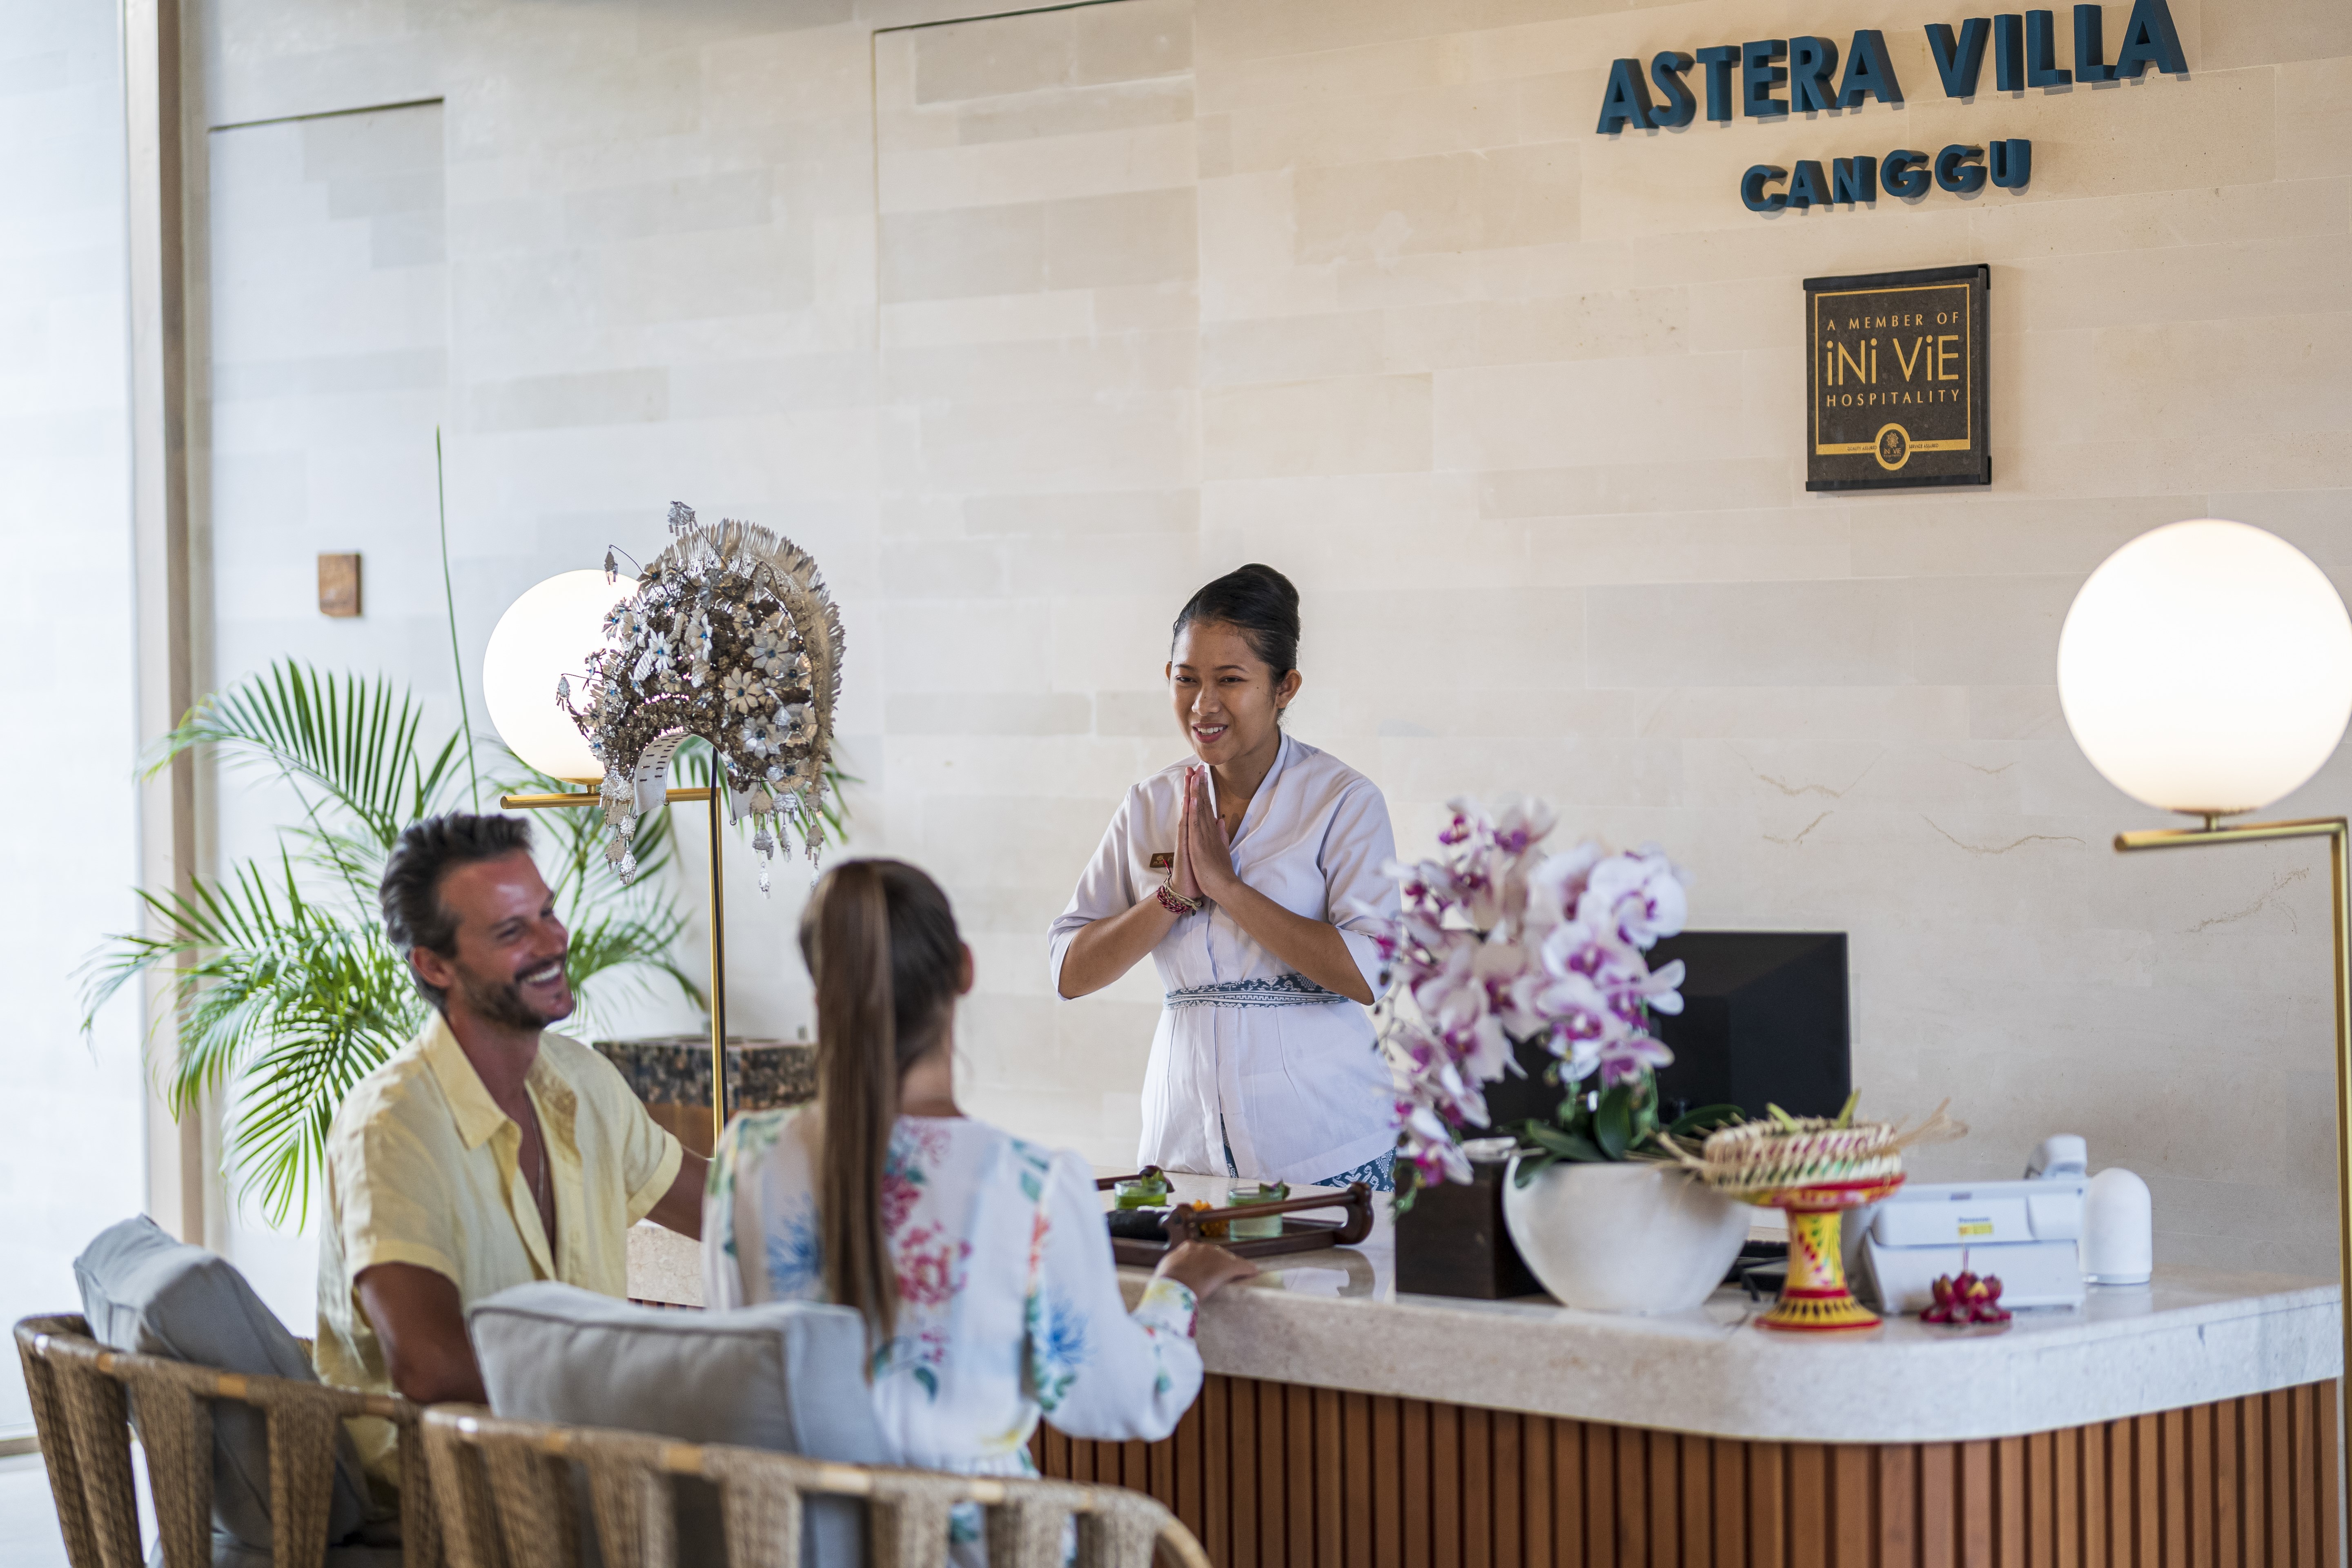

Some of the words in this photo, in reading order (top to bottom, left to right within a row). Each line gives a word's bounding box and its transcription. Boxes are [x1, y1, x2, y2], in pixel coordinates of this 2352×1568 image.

[1597, 29, 1904, 134] ASTERA
[1924, 0, 2188, 97] VILLA
[1741, 139, 2031, 212] CANGGU
[1827, 319, 1836, 331] A
[1849, 314, 1923, 330] MEMBER
[1937, 312, 1959, 325] OF
[1826, 338, 1878, 386] iNi
[1893, 334, 1959, 382] ViE
[1826, 389, 1959, 408] HOSPITALITY
